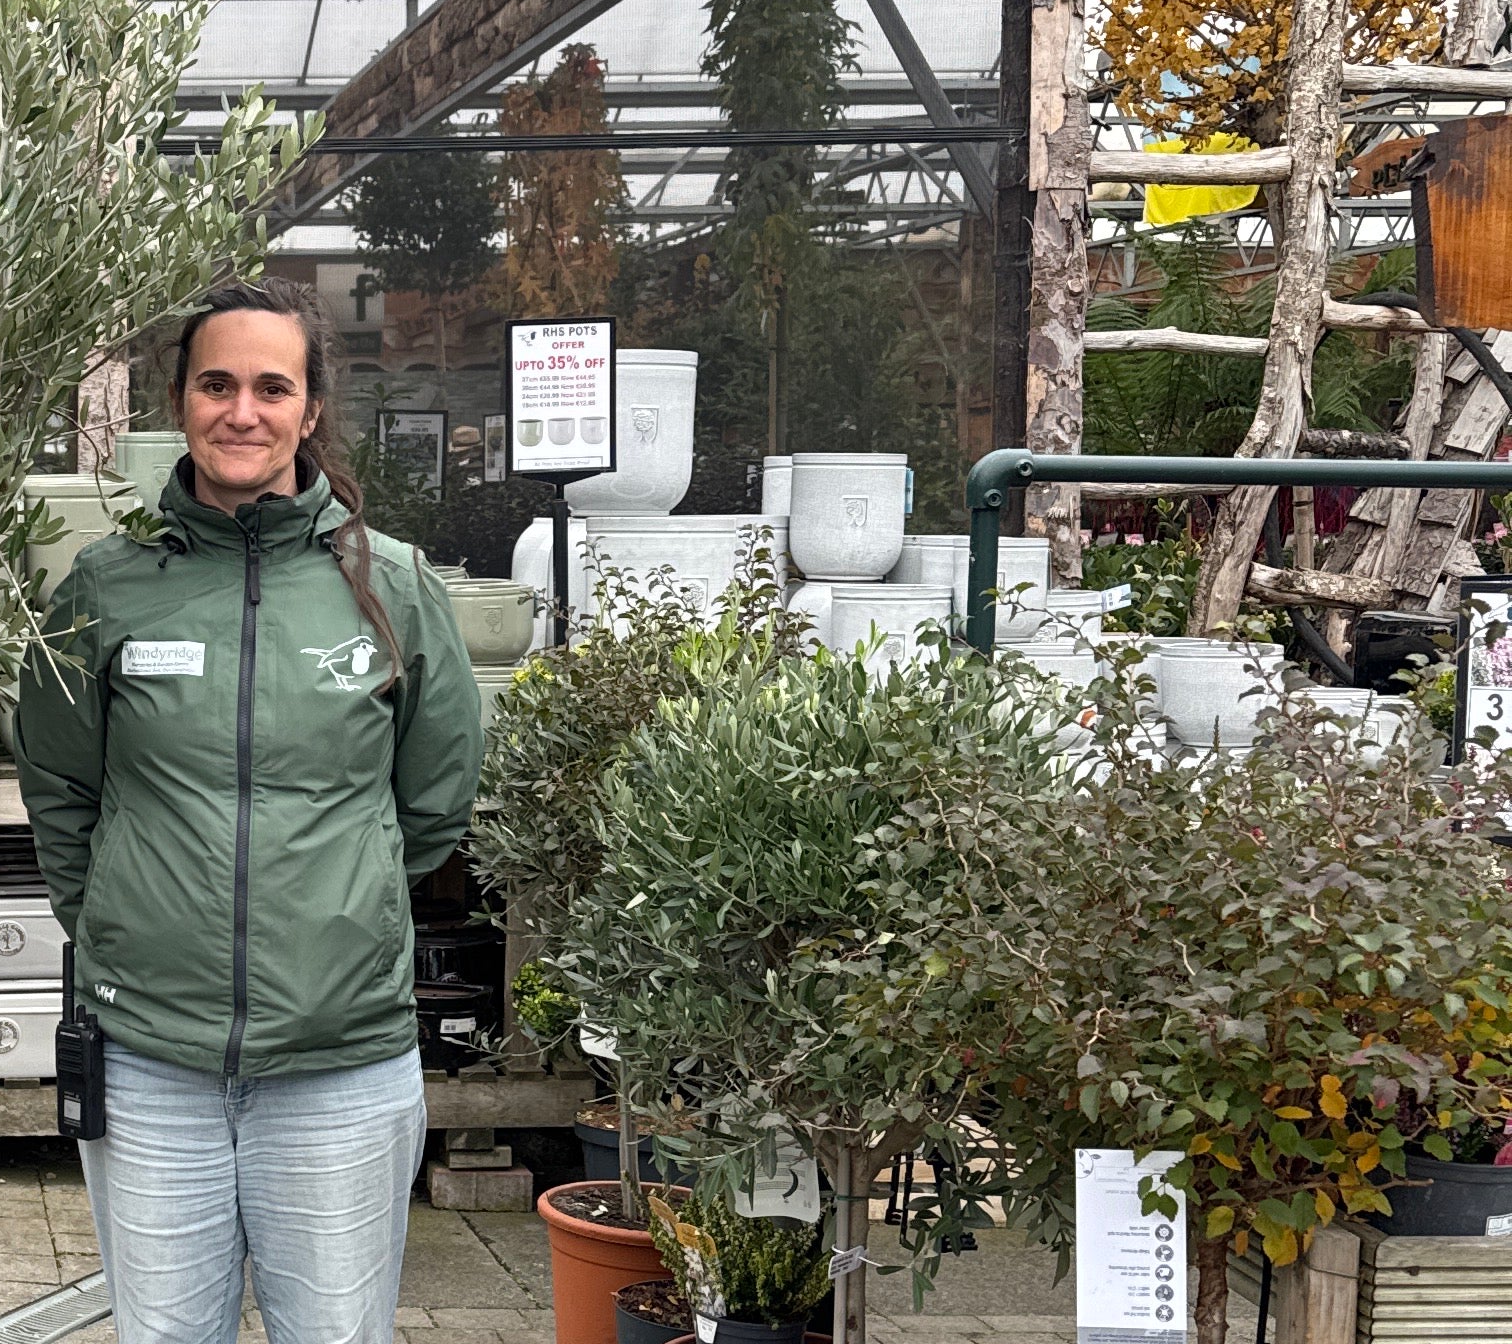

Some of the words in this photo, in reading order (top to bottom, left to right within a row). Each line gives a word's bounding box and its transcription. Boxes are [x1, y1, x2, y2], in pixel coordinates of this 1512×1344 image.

[542, 327, 565, 337] RHS
[569, 326, 597, 336] POTS
[552, 341, 584, 349] OFFER
[515, 360, 544, 371] UPTO
[548, 355, 580, 370] 35%
[585, 358, 605, 368] OFF
[126, 646, 202, 661] Windyridge
[1486, 693, 1504, 721] 3
